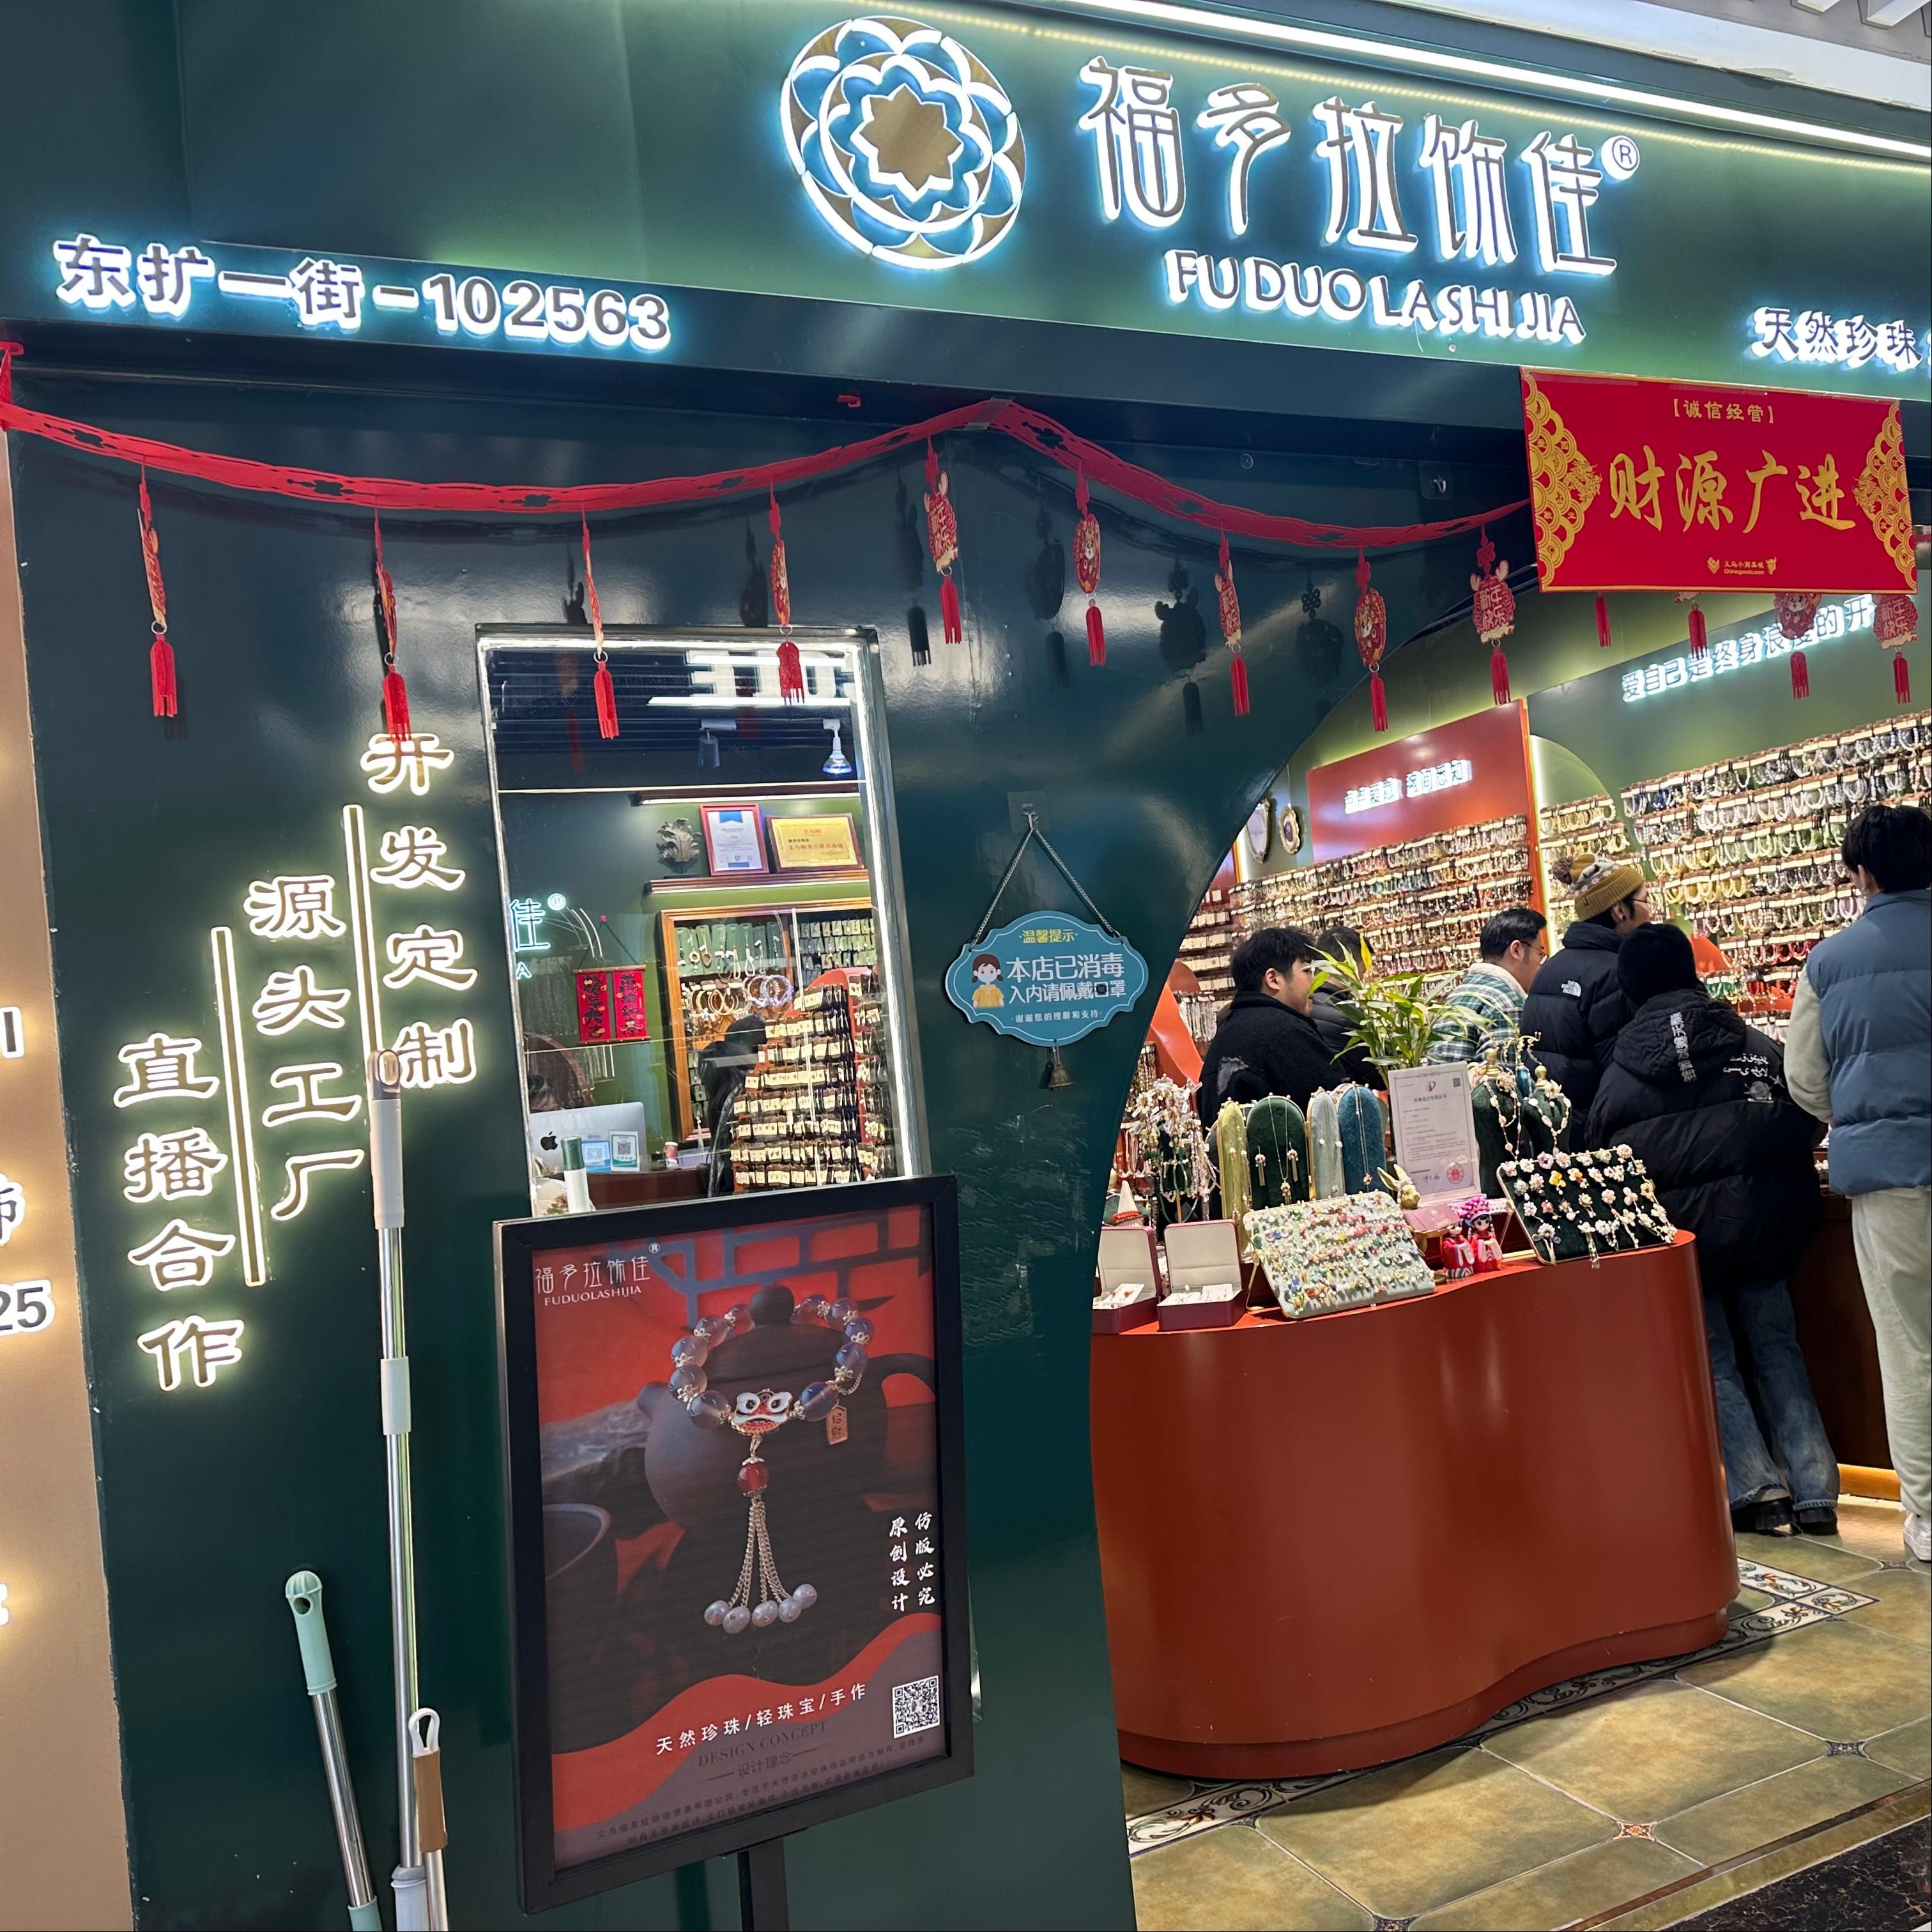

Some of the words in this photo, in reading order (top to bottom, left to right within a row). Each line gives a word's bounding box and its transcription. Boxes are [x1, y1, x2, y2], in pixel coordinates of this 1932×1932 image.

[1609, 445, 1856, 534] 财源广进
[1623, 593, 1875, 702] 爱自己是终身浪的开
[360, 733, 478, 1089] 开发定制
[1006, 952, 1124, 983] 本店已消毒
[1009, 980, 1126, 1004] 入内请佩戴口罩
[243, 874, 364, 1221] 源头工厂
[1015, 1010, 1099, 1023] 谢谢您的理解和支持
[113, 1032, 245, 1392] 直播合作
[544, 1285, 641, 1306] FUDUOLASHIJIA
[889, 1516, 910, 1612] 原创设计
[915, 1512, 935, 1606] 仿版必究
[698, 1744, 756, 1767] DESIGN
[760, 1721, 827, 1749] CONCEPT
[737, 1752, 792, 1777] 设计理念
